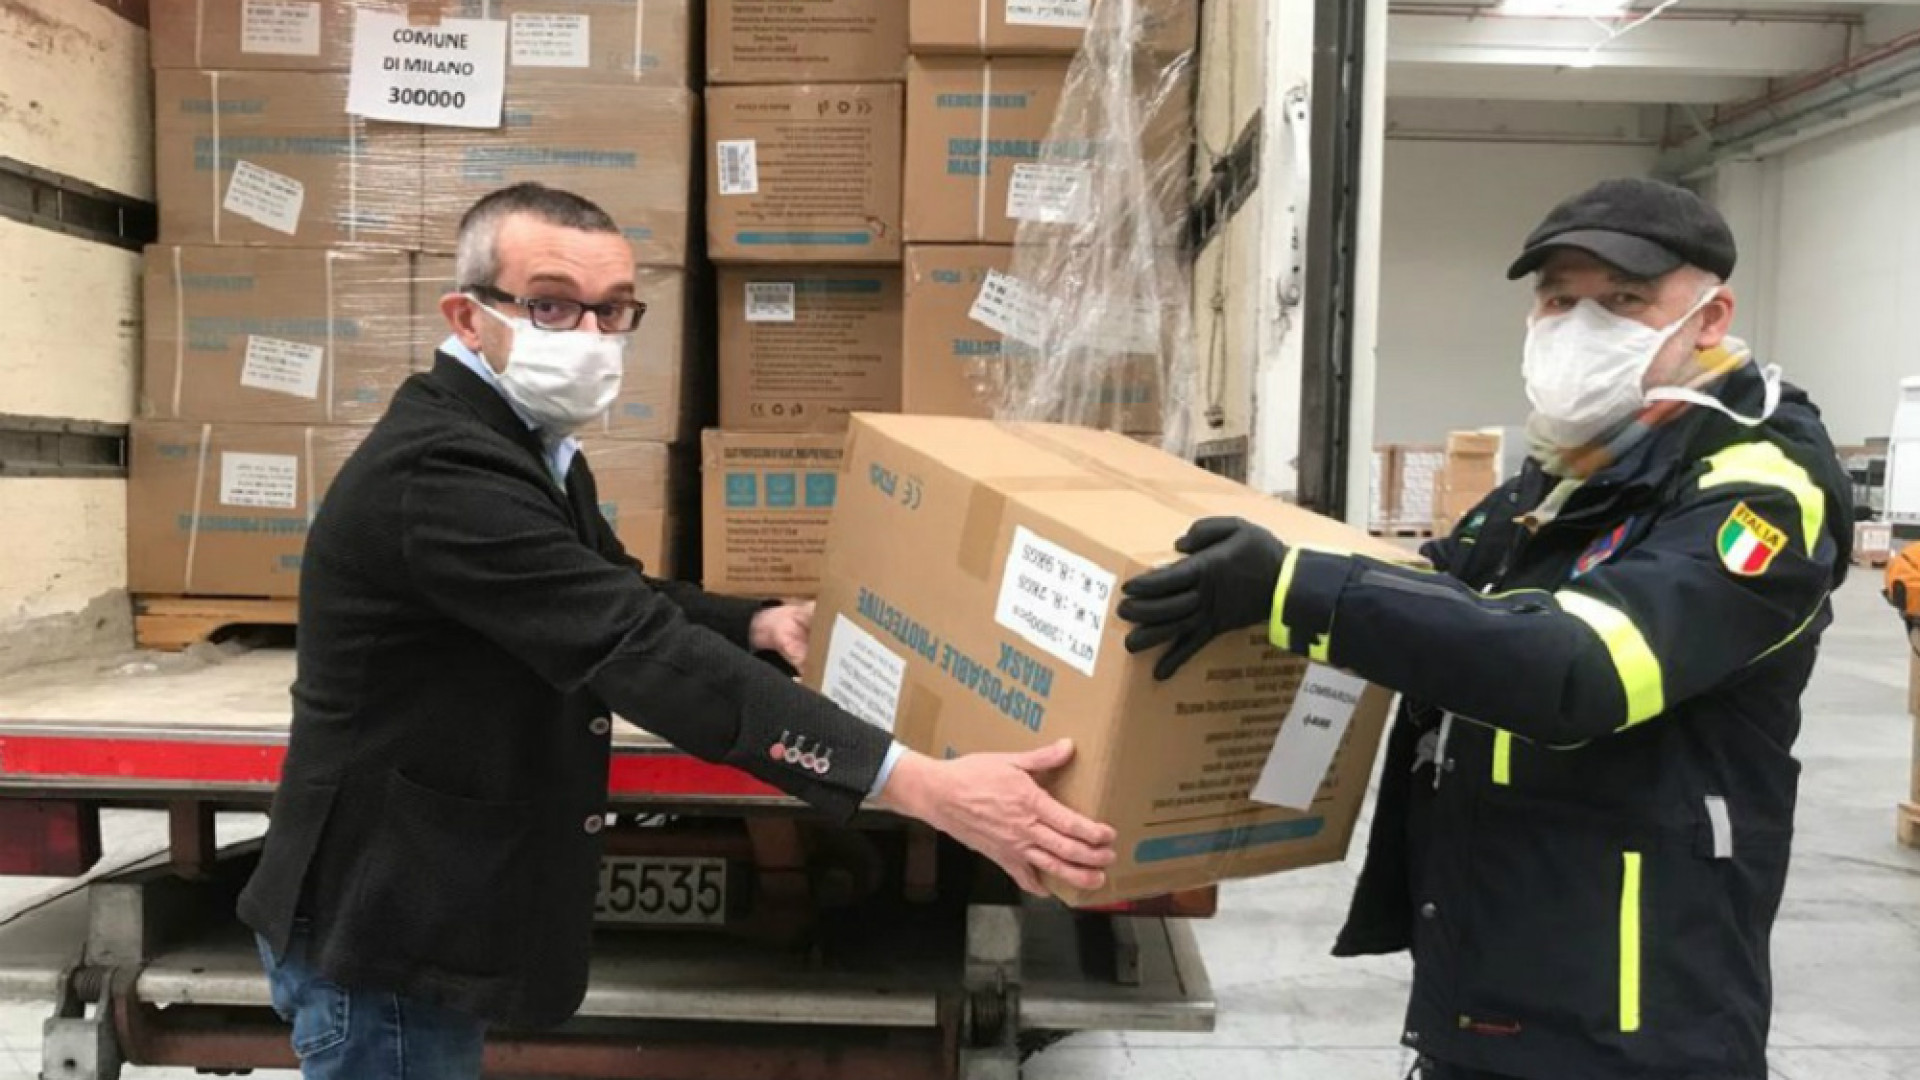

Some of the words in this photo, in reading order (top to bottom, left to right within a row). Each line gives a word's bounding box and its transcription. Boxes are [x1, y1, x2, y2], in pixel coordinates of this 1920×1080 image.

[393, 28, 469, 50] COMUNE
[382, 56, 400, 71] DI
[404, 57, 475, 76] MILANO
[388, 85, 466, 109] 300000
[1735, 504, 1780, 548] ITALIA
[856, 584, 939, 664] PROTECTIVE
[940, 643, 1044, 732] DISPOSABLE
[997, 641, 1054, 698] MASK
